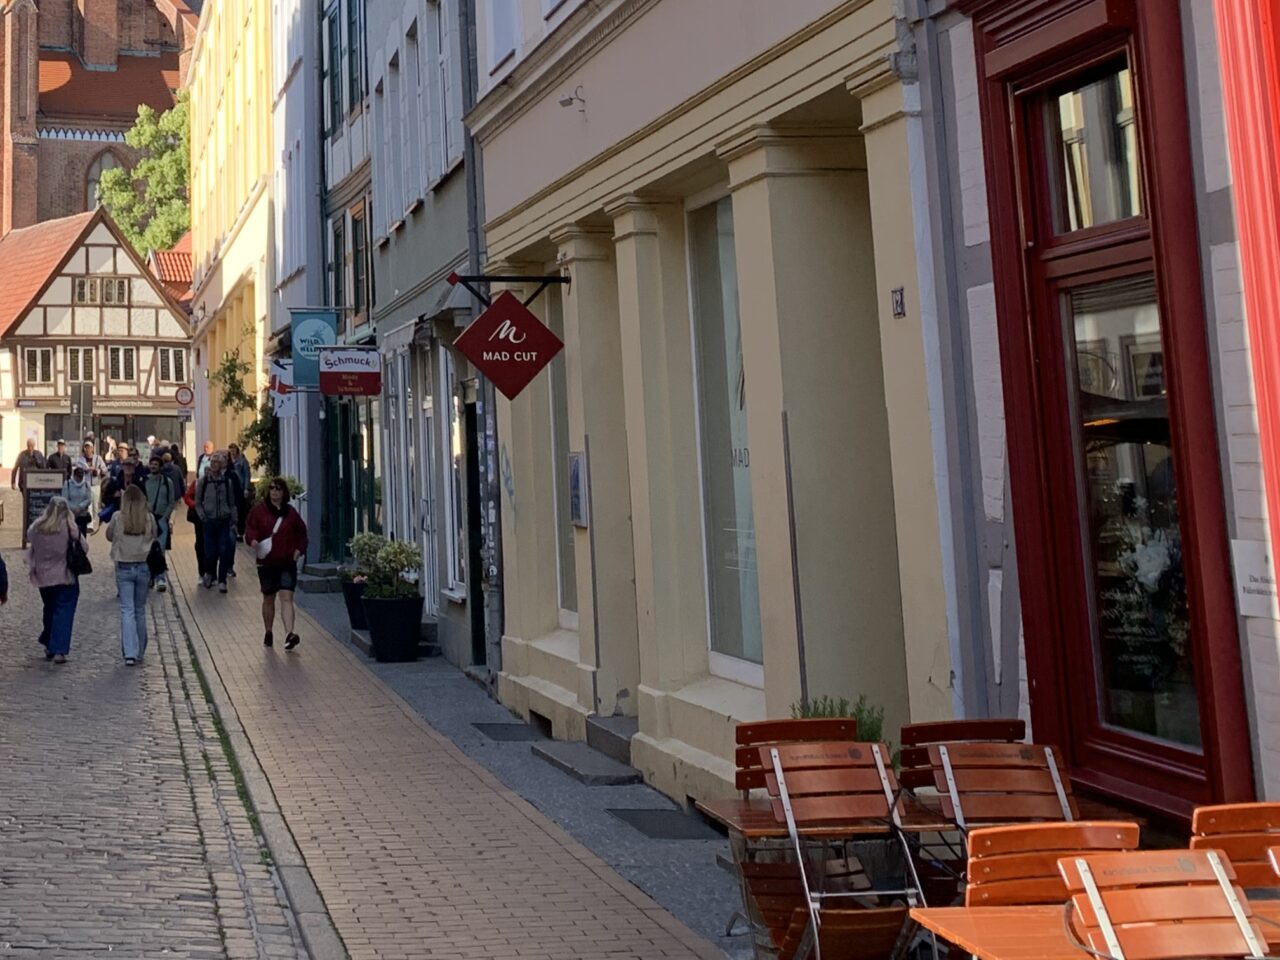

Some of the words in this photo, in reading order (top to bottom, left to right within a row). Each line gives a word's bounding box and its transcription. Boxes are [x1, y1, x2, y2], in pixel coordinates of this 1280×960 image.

[483, 351, 510, 361] MAD
[514, 351, 538, 361] CUT
[324, 356, 371, 369] Schmuck
